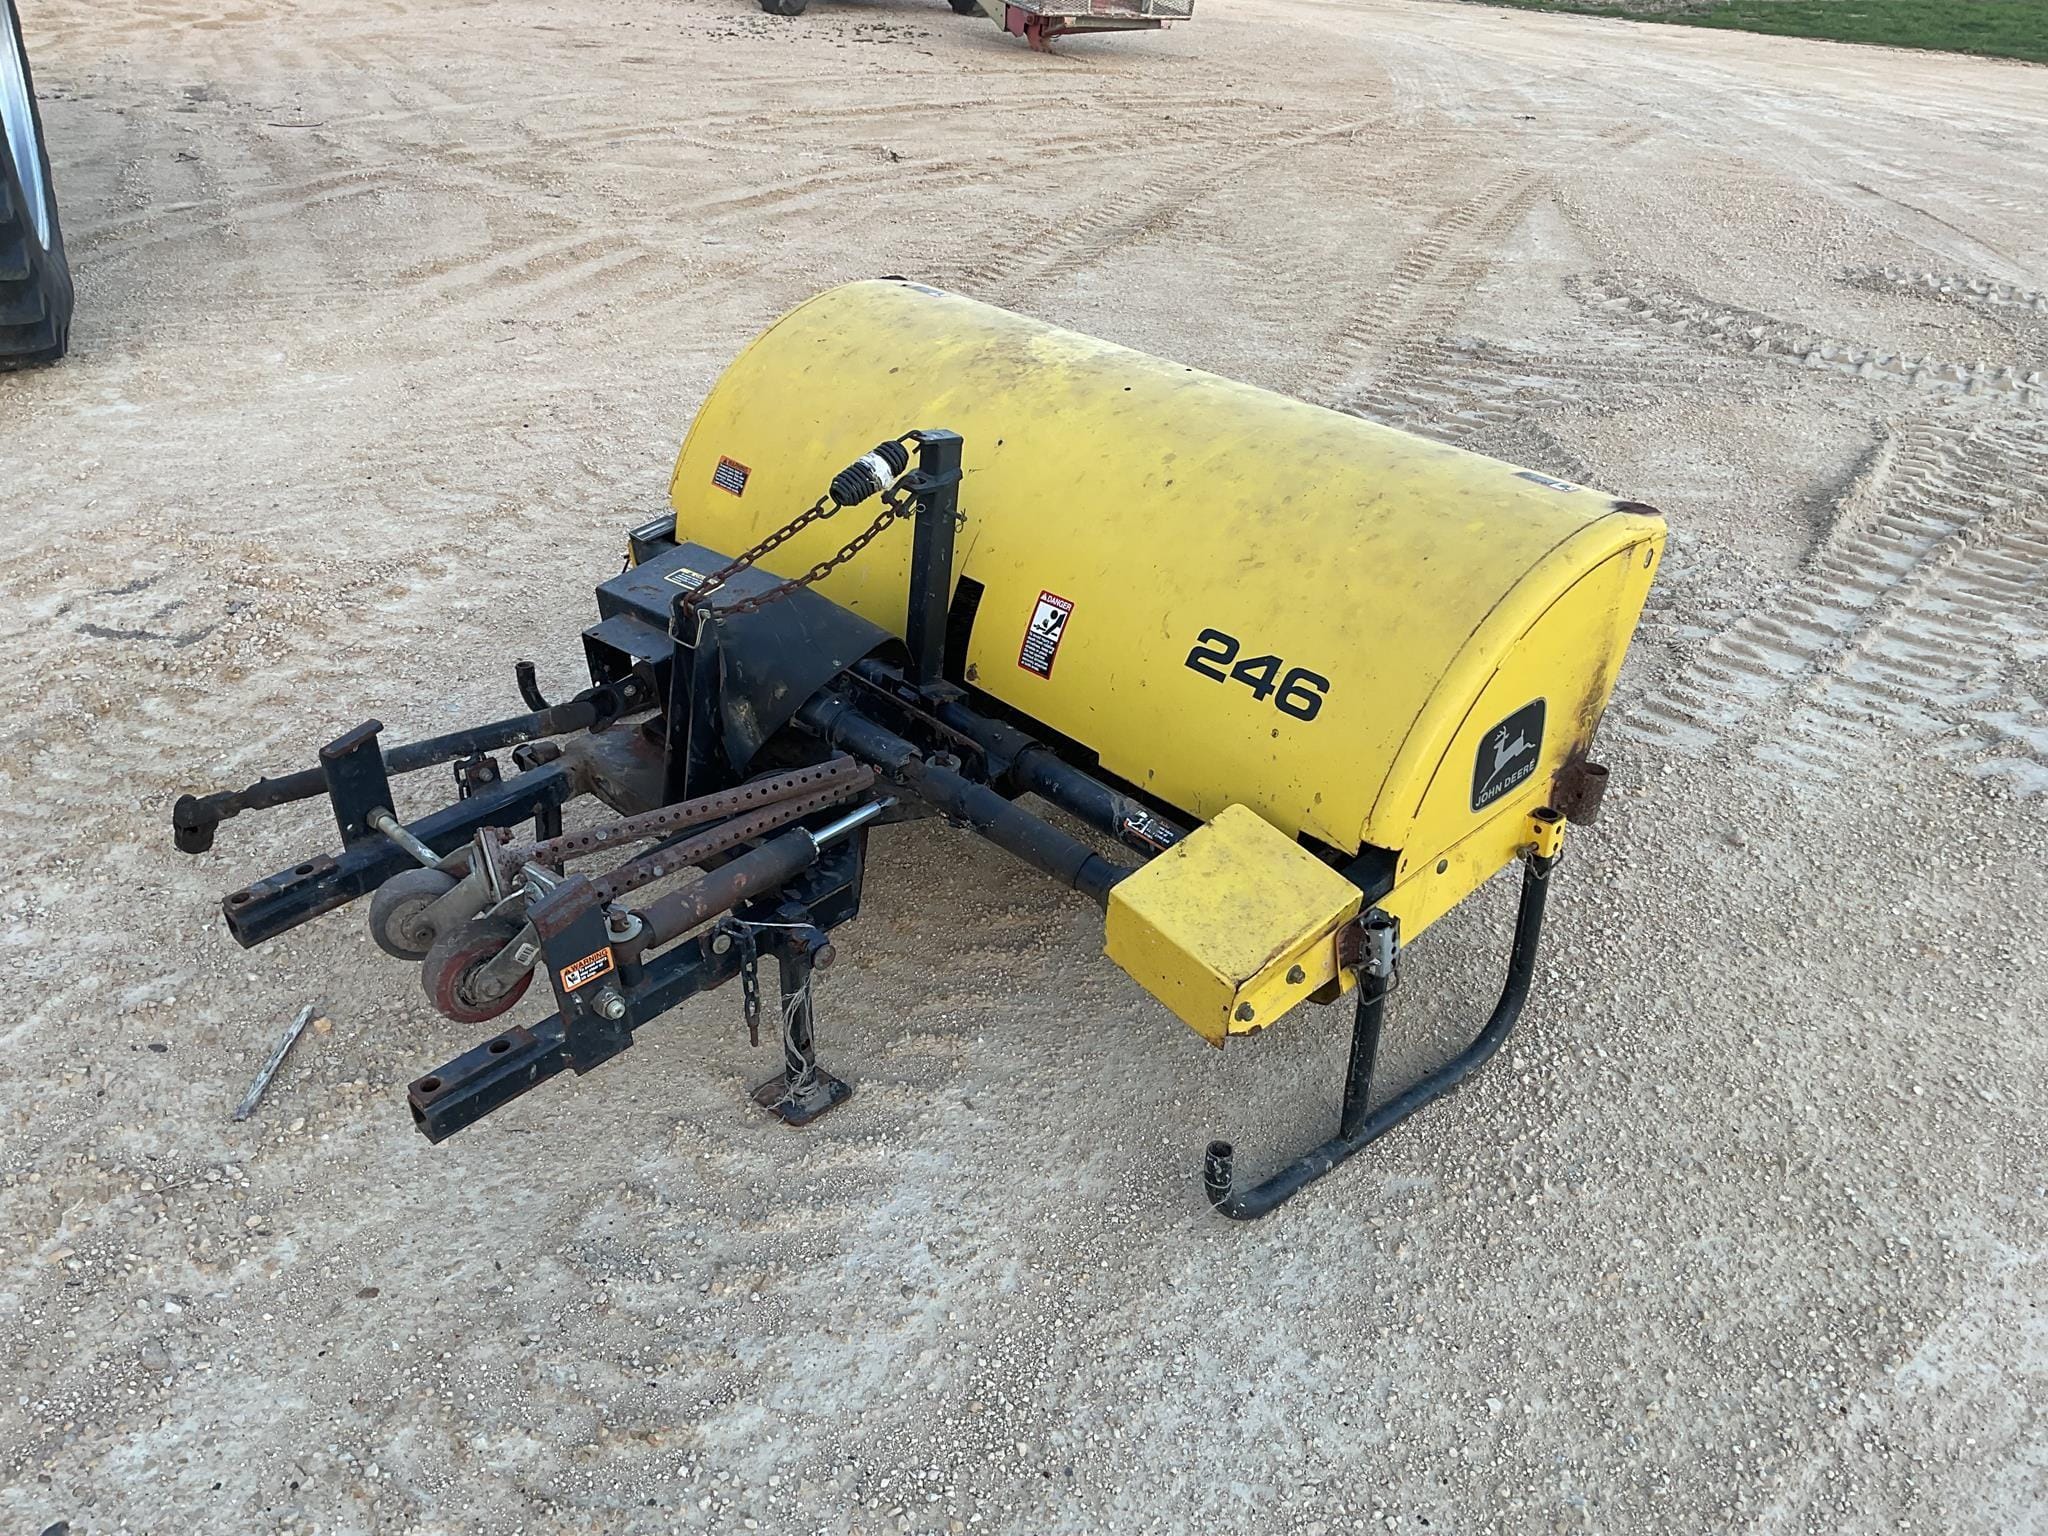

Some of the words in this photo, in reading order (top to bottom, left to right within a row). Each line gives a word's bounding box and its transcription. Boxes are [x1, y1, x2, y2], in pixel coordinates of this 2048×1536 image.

[1046, 595, 1072, 611] DANGER
[1184, 628, 1330, 721] 246
[1475, 781, 1502, 807] JOHN
[1504, 761, 1535, 789] DEERE
[571, 949, 608, 971] WARNING
